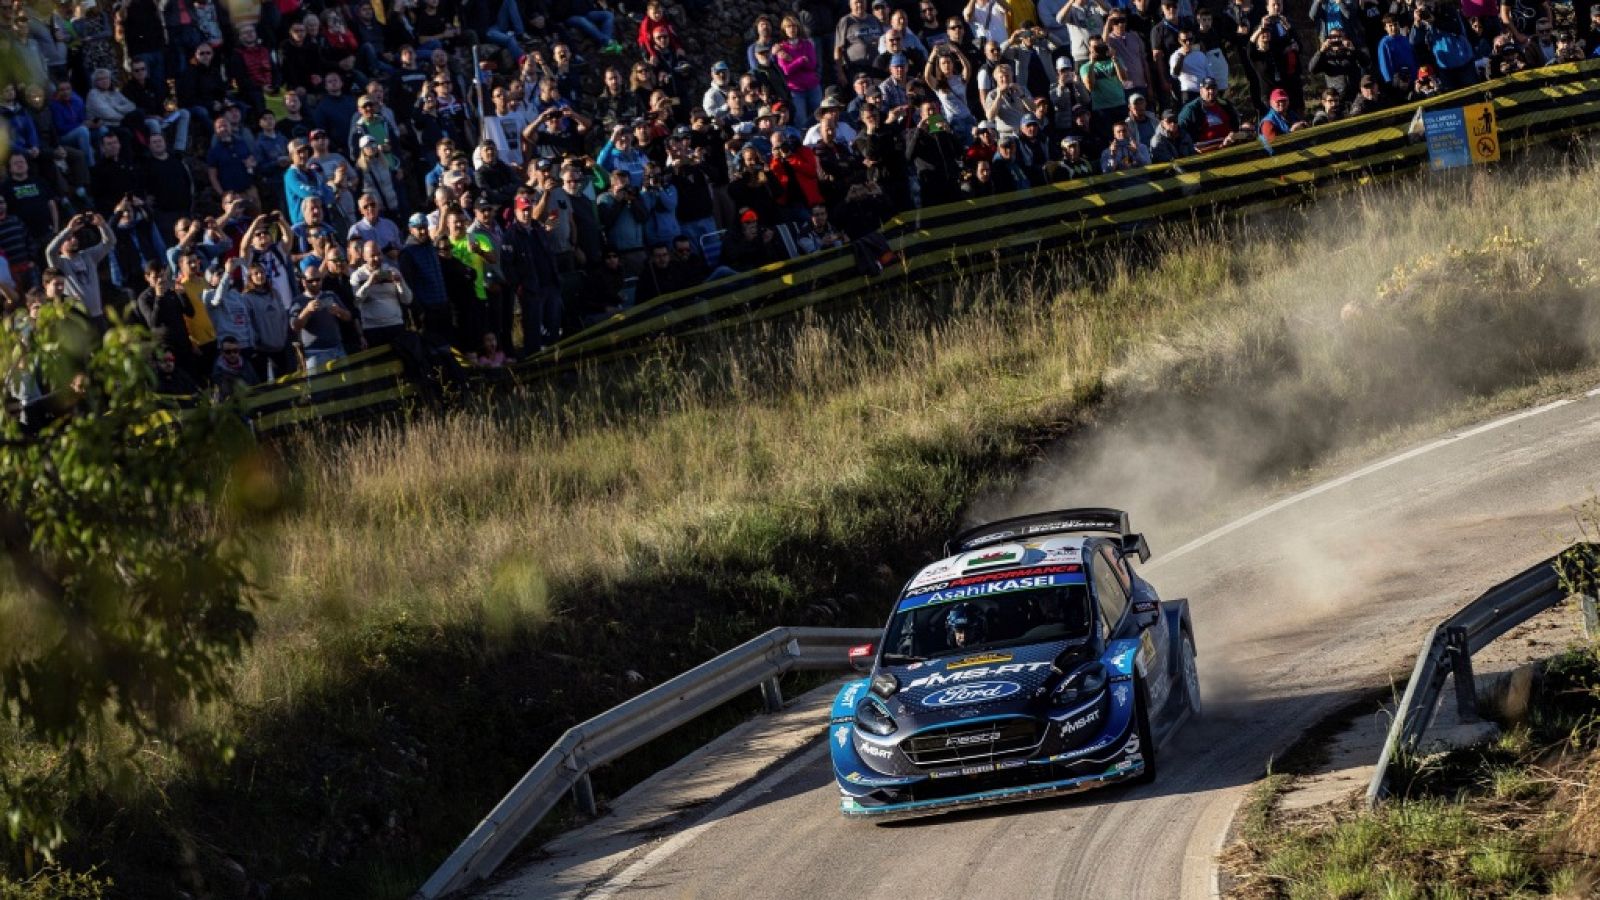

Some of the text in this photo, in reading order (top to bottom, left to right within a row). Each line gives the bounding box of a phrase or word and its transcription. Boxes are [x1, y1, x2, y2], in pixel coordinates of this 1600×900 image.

[948, 565, 1080, 588] PERFORMANCE
[918, 662, 1051, 688] MS-RT
[938, 683, 1004, 705] Ford
[1064, 709, 1099, 736] MS-RT
